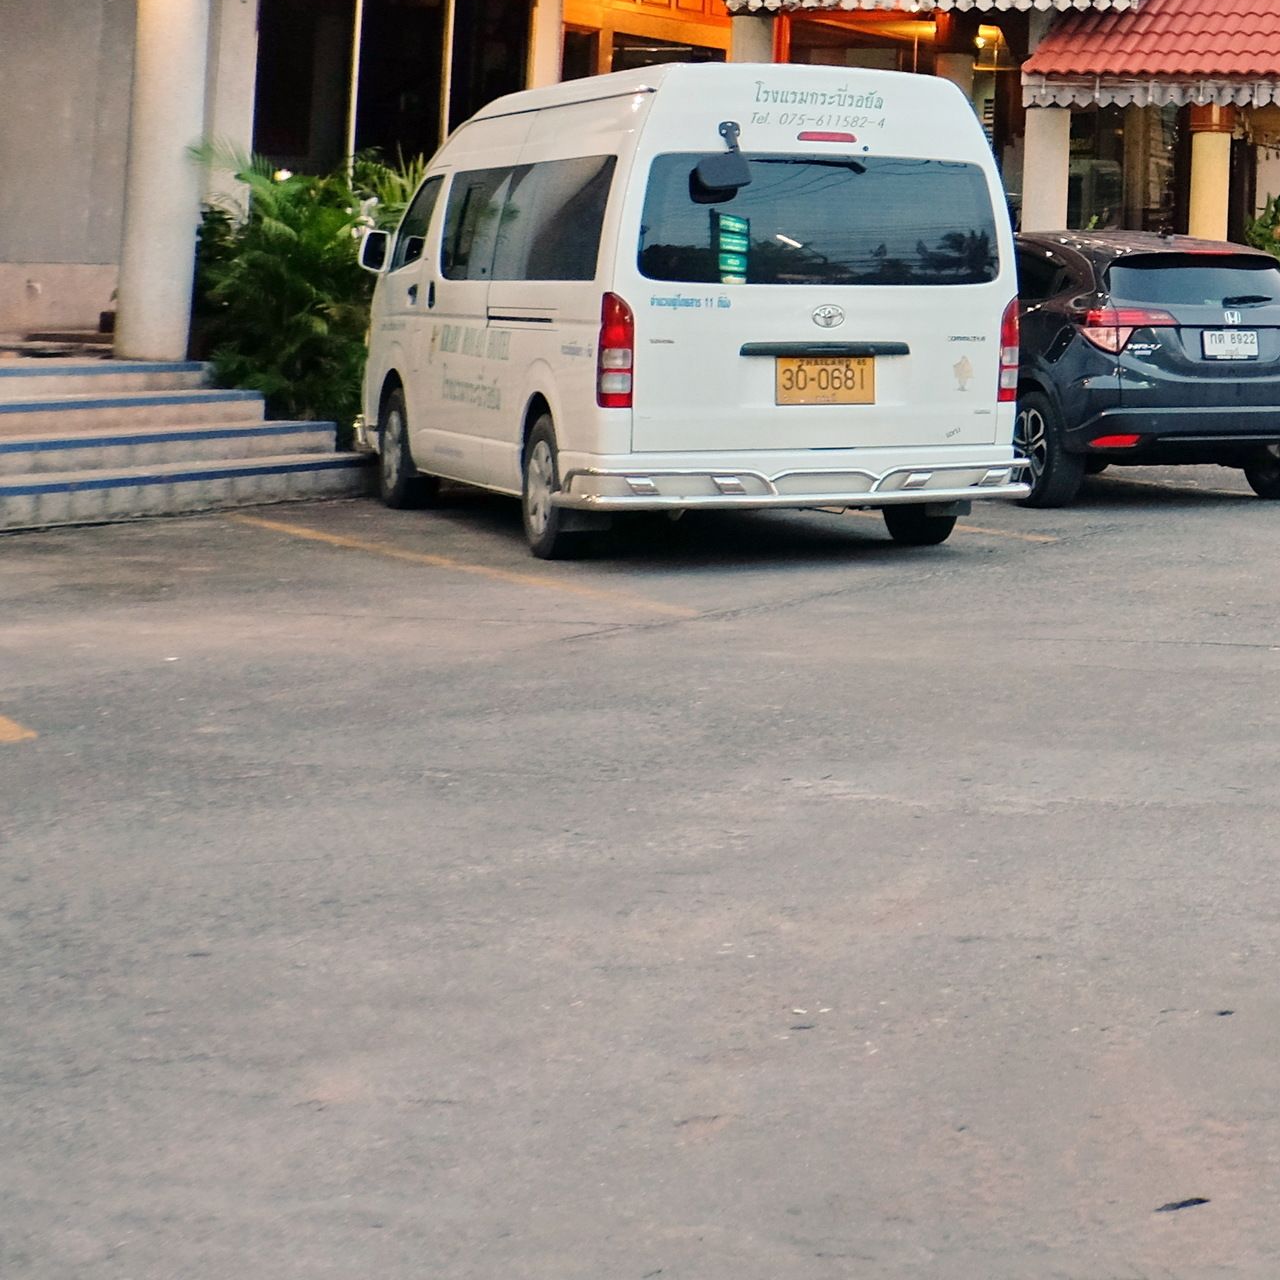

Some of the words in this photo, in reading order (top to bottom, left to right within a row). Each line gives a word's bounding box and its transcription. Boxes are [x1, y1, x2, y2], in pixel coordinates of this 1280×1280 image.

[750, 111, 771, 125] Tel.
[779, 112, 886, 129] 075-611582-4
[782, 368, 865, 391] 30-0681
